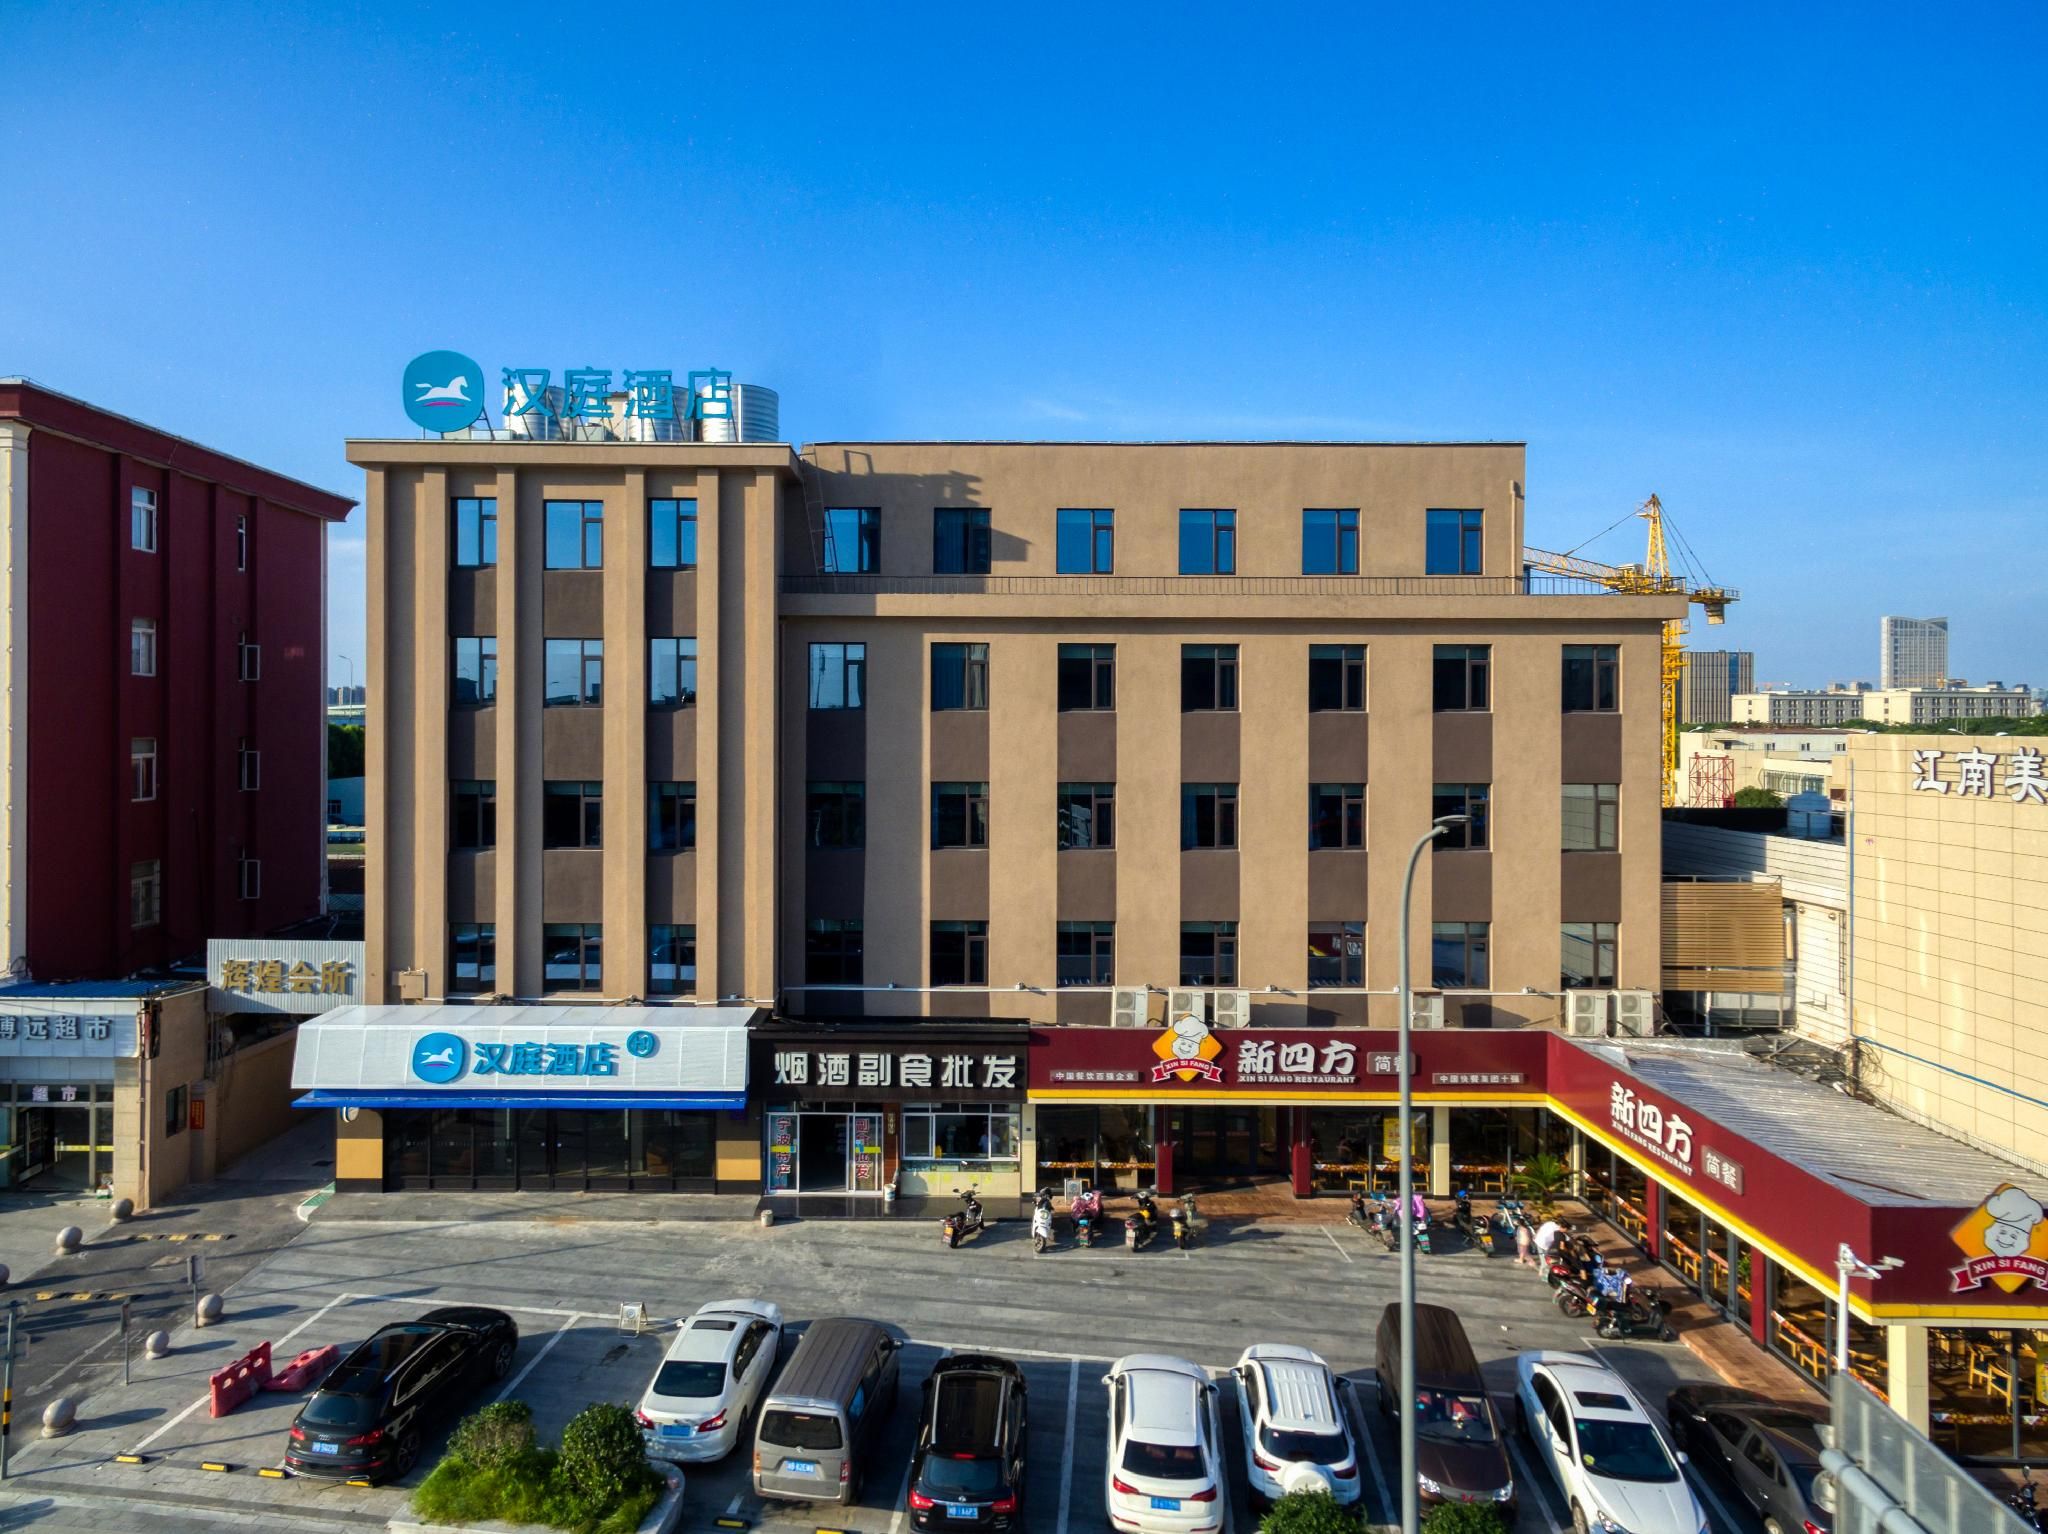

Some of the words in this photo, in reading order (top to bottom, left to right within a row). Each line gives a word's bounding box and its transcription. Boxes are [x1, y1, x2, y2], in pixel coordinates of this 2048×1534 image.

[502, 366, 733, 419] 汉庭酒店
[1911, 746, 2048, 803] 江南美
[221, 959, 351, 994] 辉煌会所
[474, 1041, 616, 1076] 汉庭酒店
[774, 1052, 1016, 1088] 烟酒副食批发
[1165, 1061, 1178, 1070] XIN
[1190, 1061, 1210, 1070] FANG
[1238, 1040, 1356, 1074] 新四方
[32, 1085, 77, 1102] 超市
[1239, 1075, 1256, 1083] XIN
[1258, 1075, 1267, 1083] SI
[1269, 1075, 1293, 1083] FANG
[1295, 1075, 1356, 1083] RESTAURANT
[1611, 1081, 1693, 1163] 新四方
[1612, 1120, 1624, 1133] XIN
[1631, 1132, 1647, 1147] FANG
[1648, 1142, 1693, 1176] RESTAURANT
[1706, 1152, 1737, 1189] 简餐
[1973, 1261, 1997, 1274] XIN
[1998, 1259, 2010, 1268] SI
[2013, 1260, 2045, 1275] FANG
